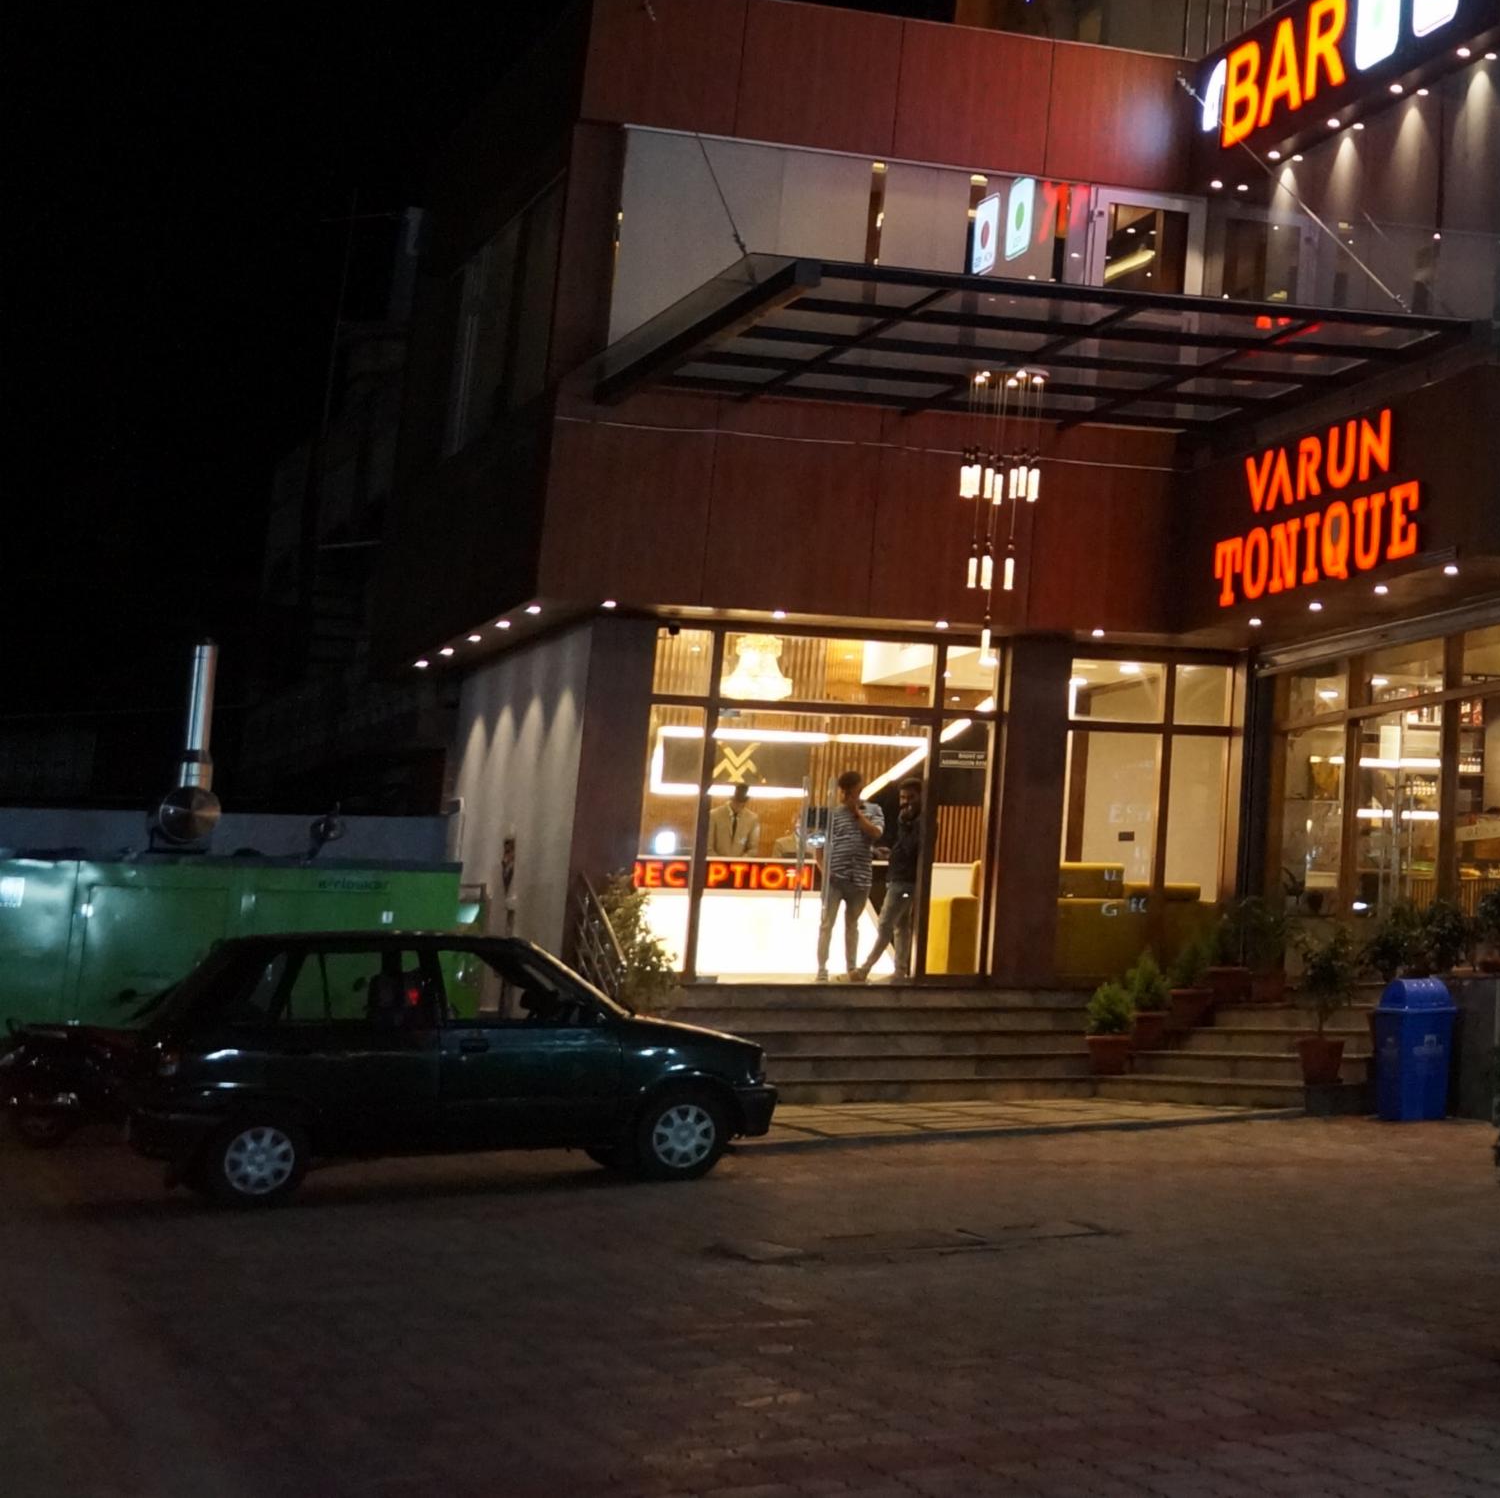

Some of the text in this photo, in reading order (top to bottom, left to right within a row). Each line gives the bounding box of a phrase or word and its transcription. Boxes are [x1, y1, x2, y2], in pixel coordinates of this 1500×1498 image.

[1246, 409, 1392, 513] VARUN
[1215, 480, 1421, 608] TONIQUE
[634, 860, 811, 890] ECPTION
